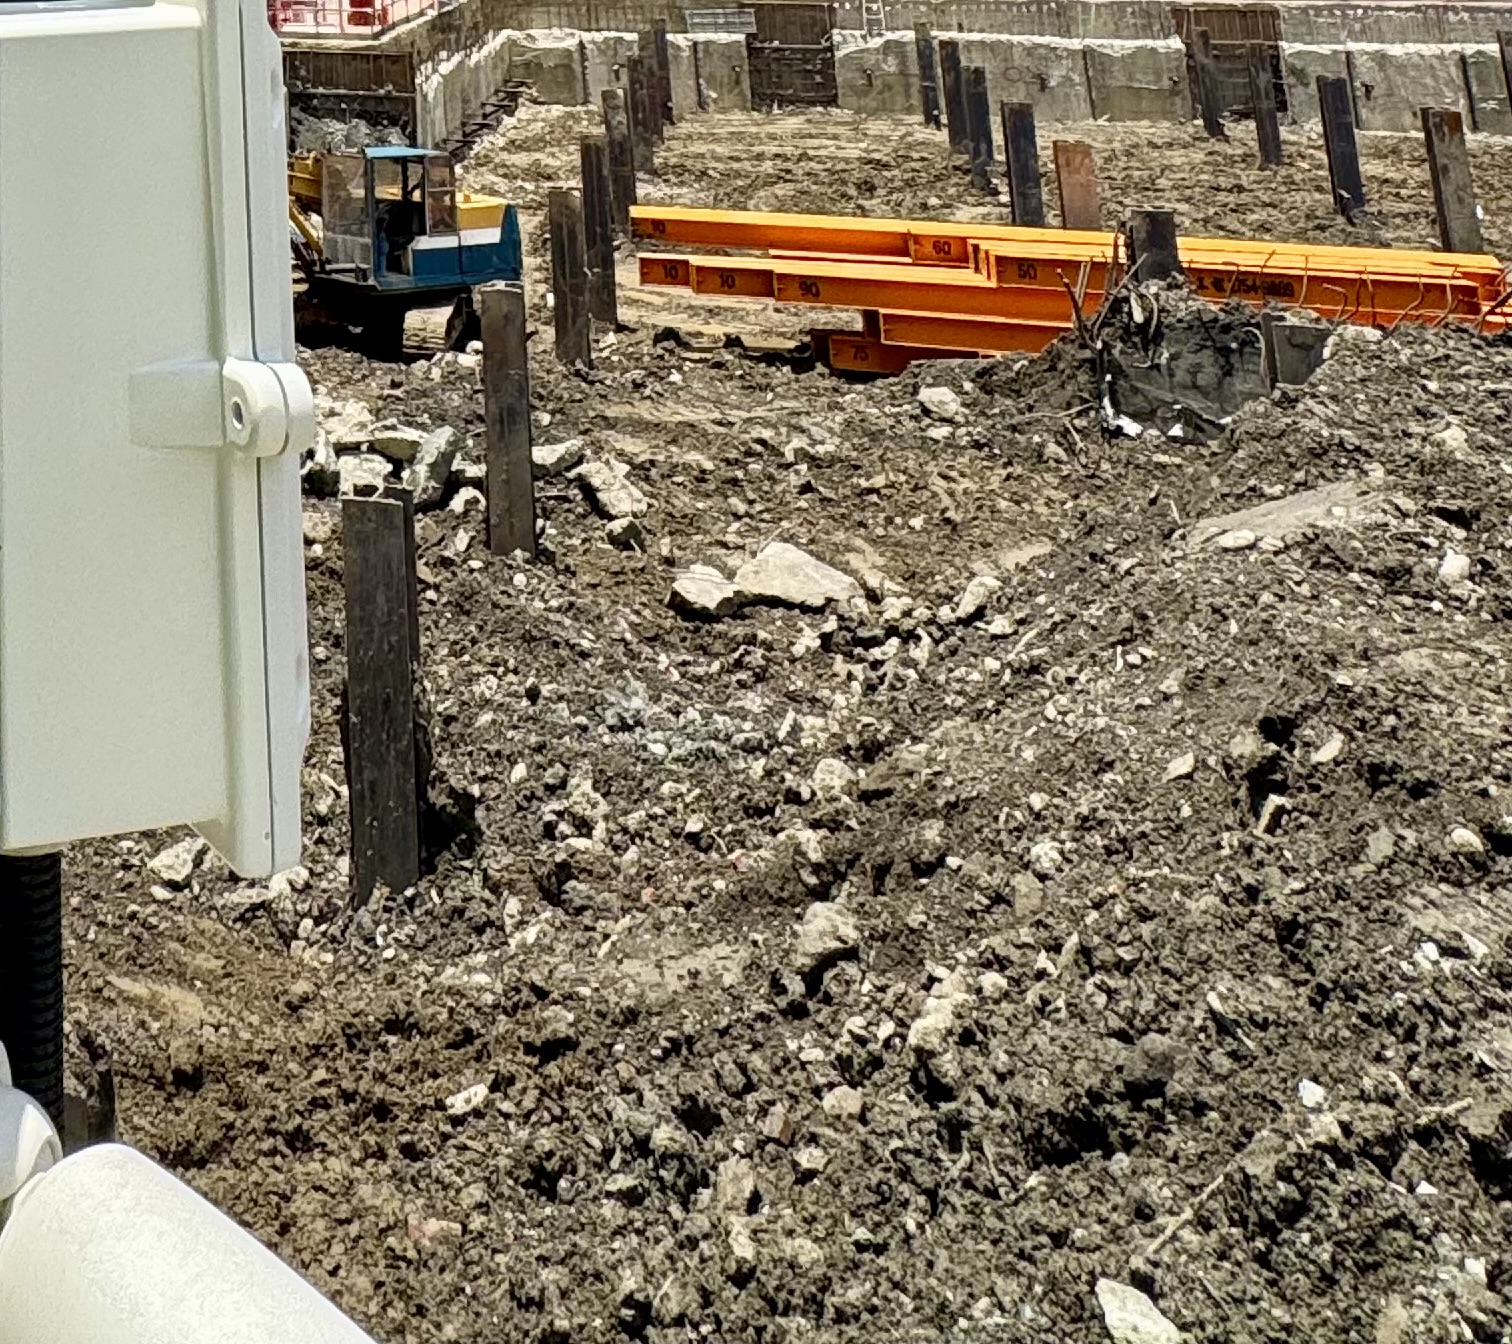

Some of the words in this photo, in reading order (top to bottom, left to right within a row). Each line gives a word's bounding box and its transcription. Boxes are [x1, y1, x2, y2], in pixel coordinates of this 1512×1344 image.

[663, 264, 679, 280] 10
[718, 271, 736, 289] 10
[1017, 262, 1037, 280] 50
[798, 280, 820, 298] 90
